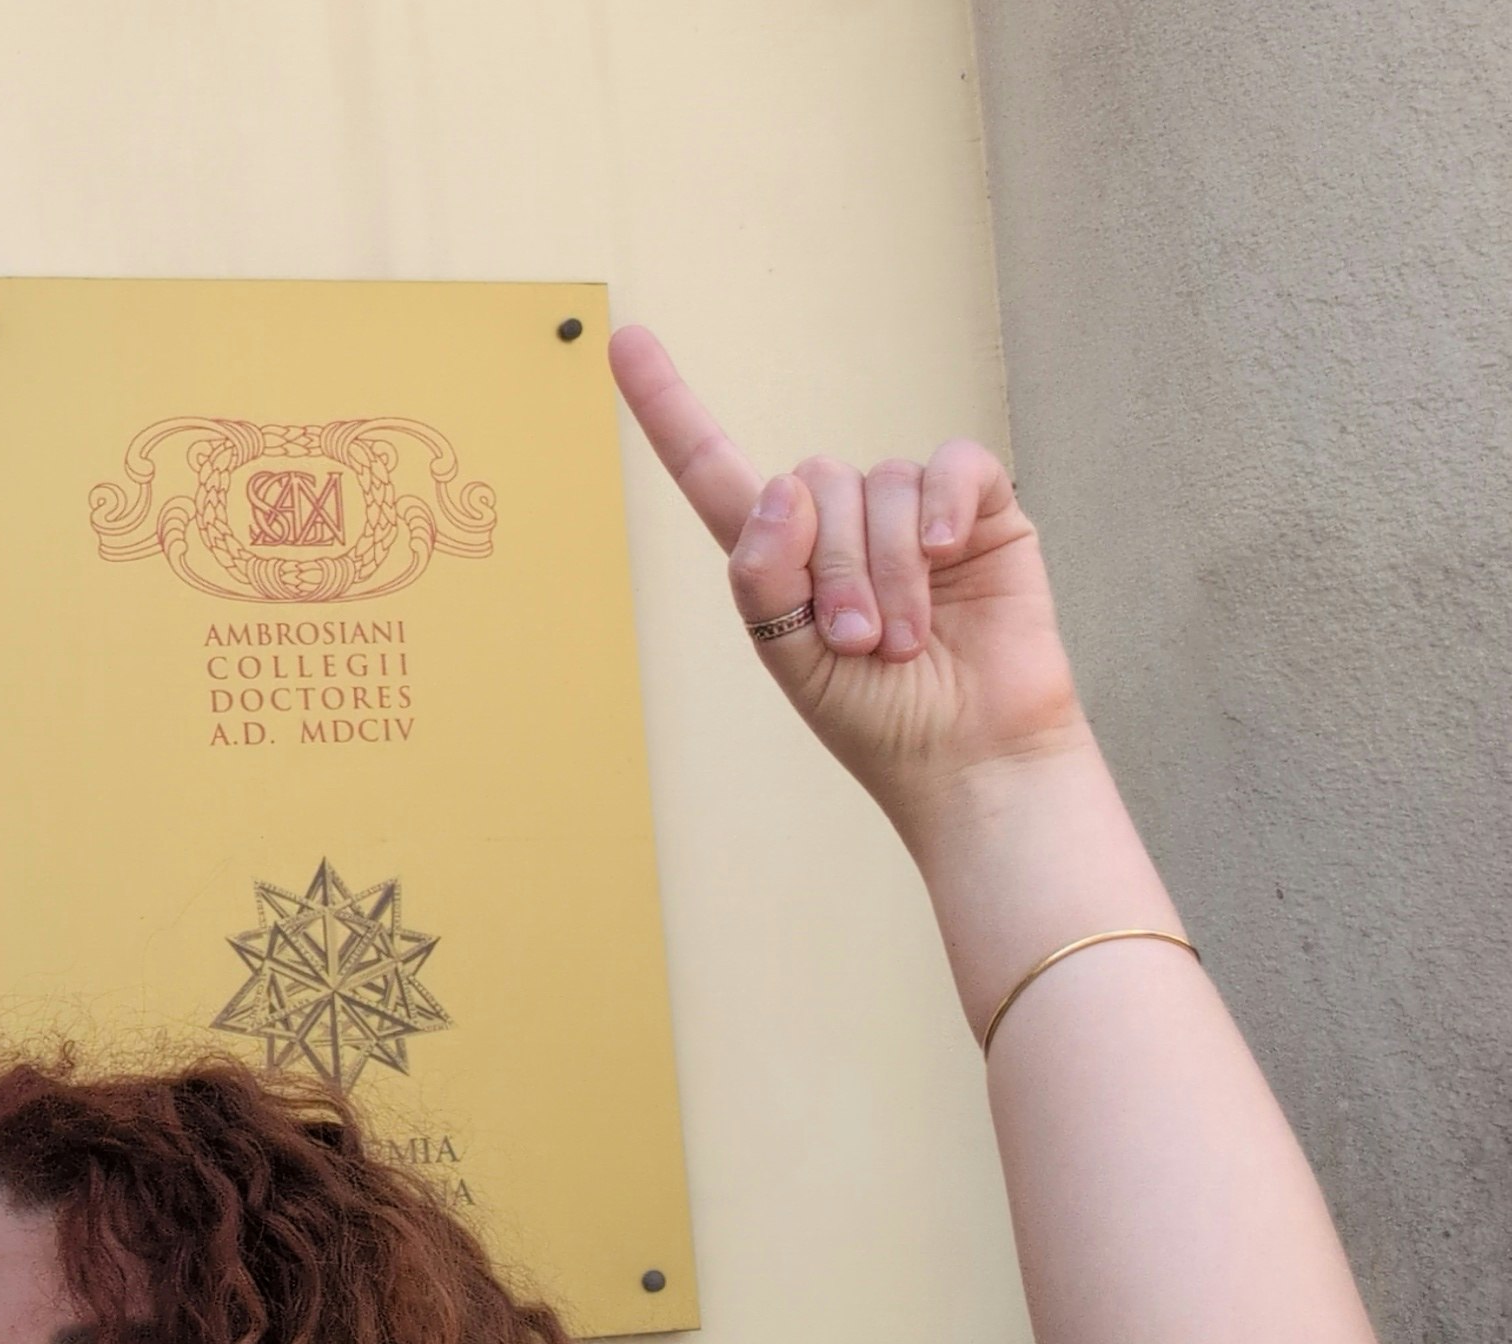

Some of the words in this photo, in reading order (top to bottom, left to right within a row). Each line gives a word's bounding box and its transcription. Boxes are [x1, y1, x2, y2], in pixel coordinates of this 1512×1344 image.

[203, 620, 406, 647] AMBROSIANI
[207, 652, 408, 680] COLLEGII
[210, 685, 412, 714] DOCTORES
[210, 721, 275, 746] A.D.
[300, 717, 415, 744] MDCIV
